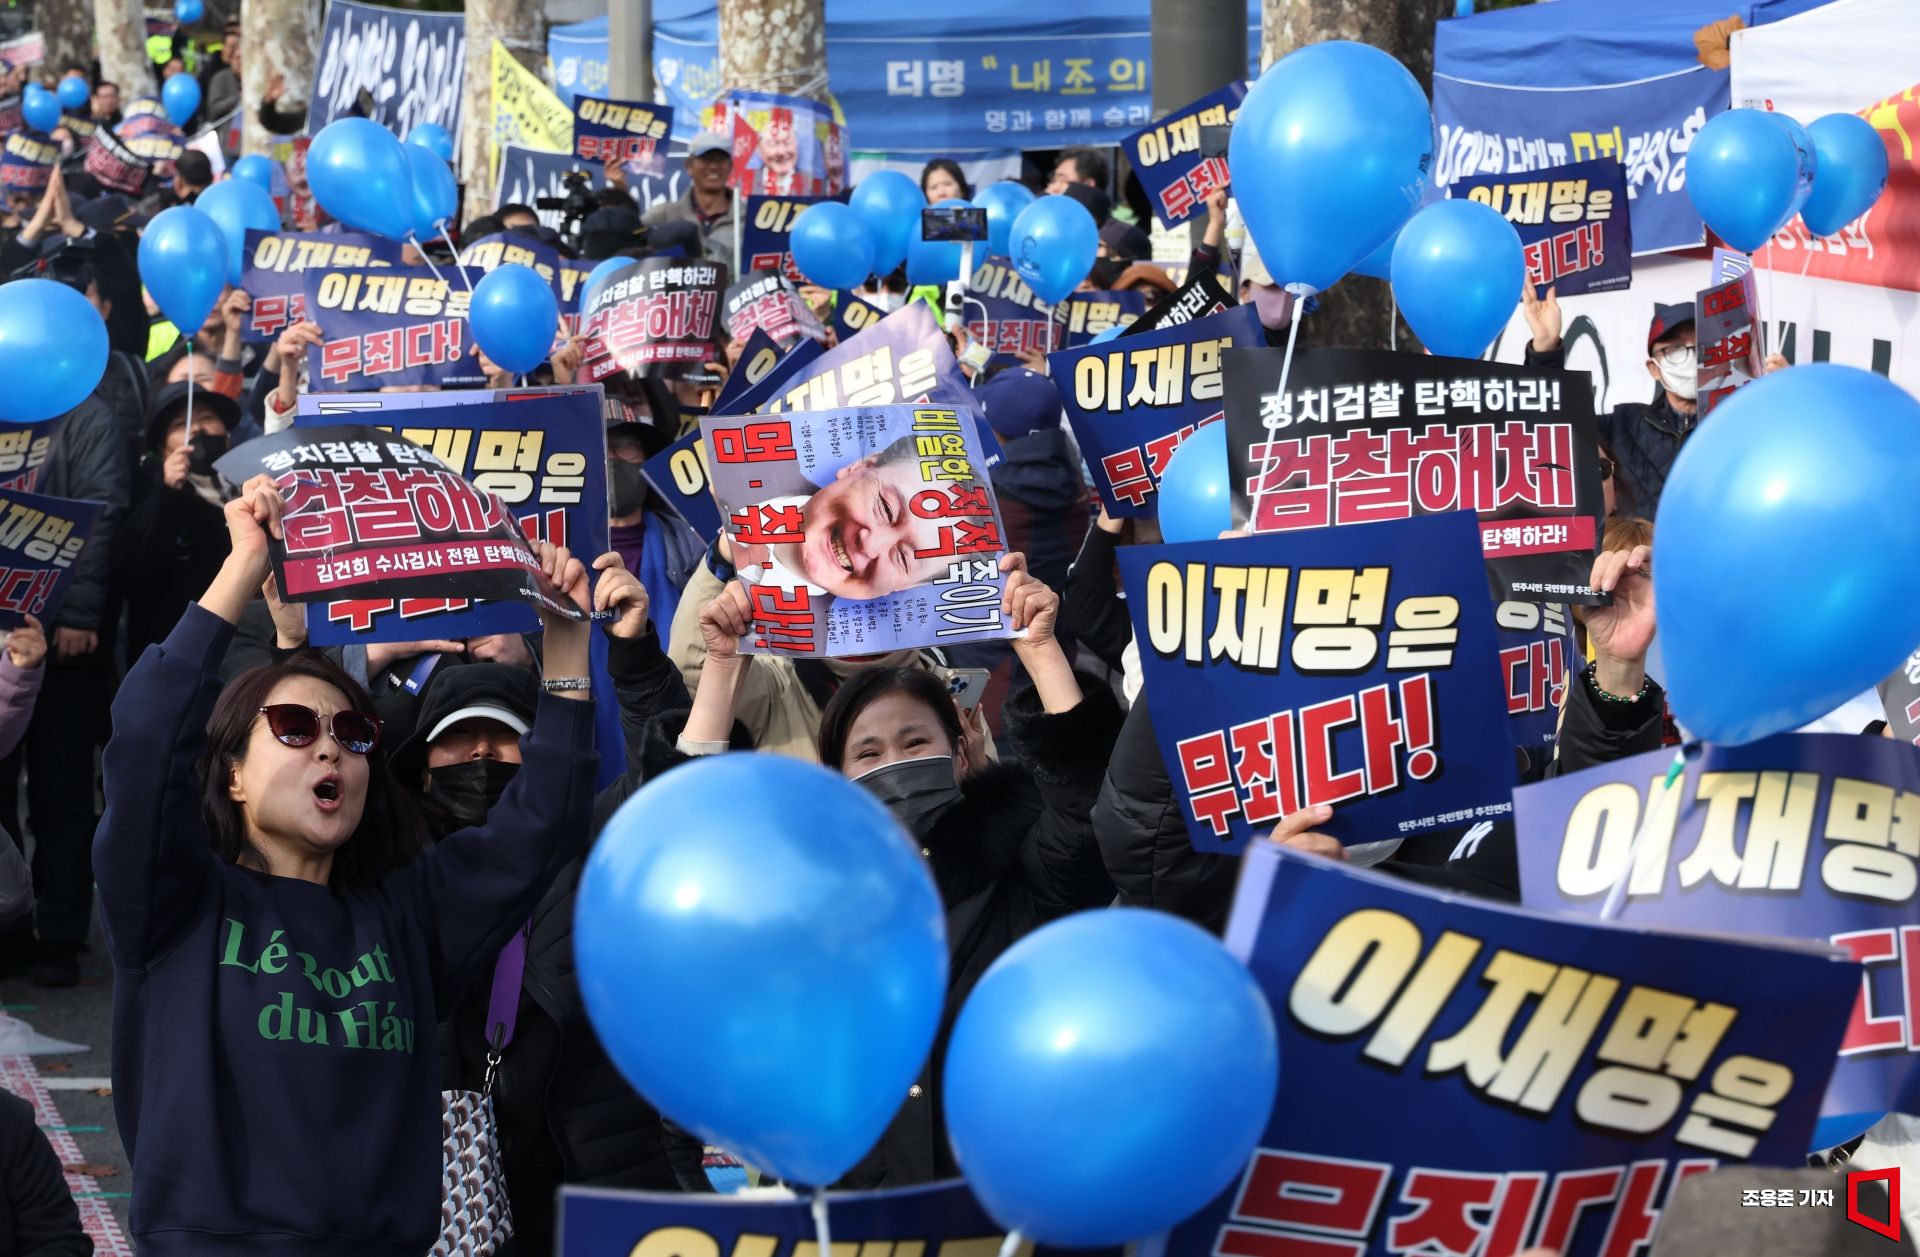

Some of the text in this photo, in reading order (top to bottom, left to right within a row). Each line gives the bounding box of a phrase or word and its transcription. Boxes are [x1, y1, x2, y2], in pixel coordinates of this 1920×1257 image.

[886, 60, 966, 97] 더명
[648, 266, 718, 290] 탄핵하라!
[320, 318, 462, 384] 무죄다!
[1259, 380, 1561, 430] 정치검찰 탄핵하라!
[261, 440, 383, 472] 정치검찰
[1246, 421, 1577, 535] 검찰해체
[274, 466, 520, 554] 검찰해
[909, 409, 1005, 638] 비열한 정적 죽이기
[1482, 524, 1568, 550] 탄핵하라!
[316, 556, 370, 584] 김건희
[375, 549, 442, 579] 수사검사
[448, 546, 481, 567] 전원
[1146, 561, 1460, 671] 이재명은
[1175, 672, 1439, 836] 무죄다!
[1398, 801, 1512, 832] 민주시민 국민항쟁 추진연대
[219, 918, 288, 974] Lé
[257, 991, 330, 1046] du
[1289, 907, 1795, 1159] 이재명은
